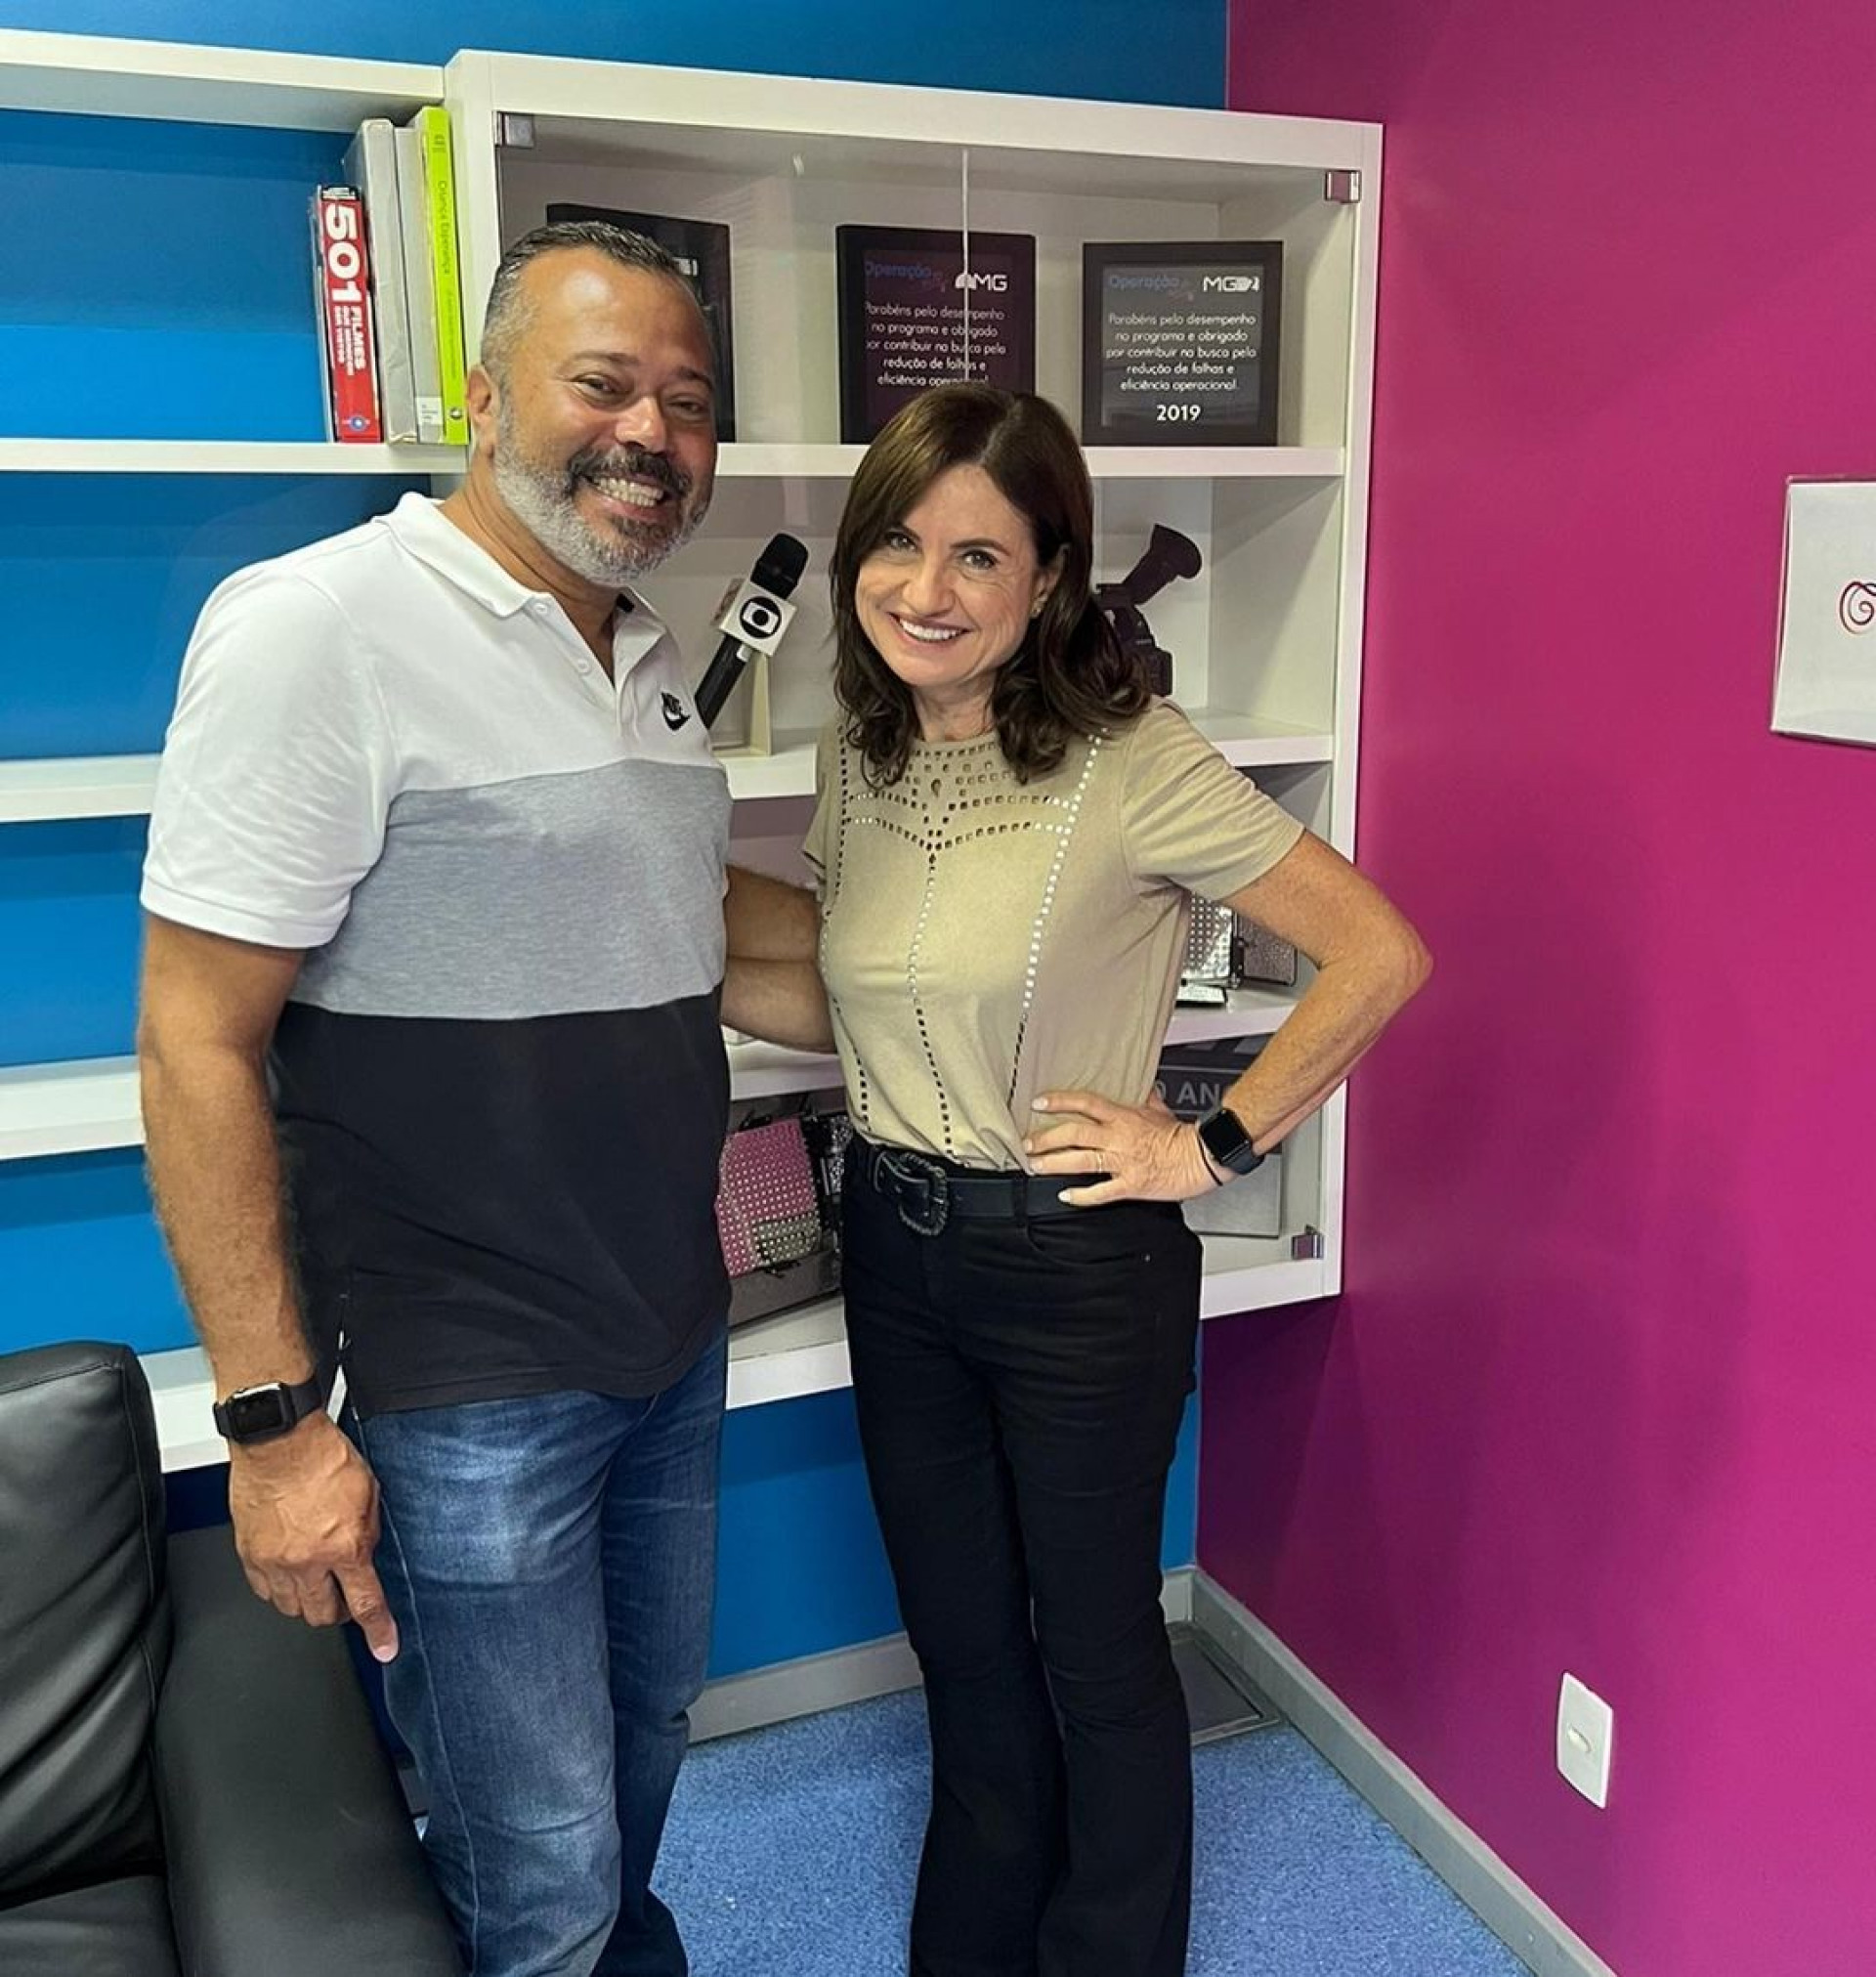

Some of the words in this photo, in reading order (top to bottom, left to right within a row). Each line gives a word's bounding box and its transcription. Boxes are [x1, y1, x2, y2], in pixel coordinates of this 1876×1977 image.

[325, 202, 362, 302] 501
[914, 304, 938, 319] pelo
[1109, 312, 1158, 324] Parabéns
[1160, 313, 1184, 326] pelo
[1186, 313, 1257, 326] desempenho
[351, 305, 367, 369] FILMES
[872, 323, 885, 333] no
[887, 323, 939, 336] programa
[941, 325, 949, 335] e
[1115, 332, 1130, 342] no
[1132, 332, 1185, 344] programa
[1187, 333, 1195, 342] e
[1198, 329, 1248, 344] obrigado
[883, 339, 932, 352] contribuir
[934, 342, 948, 353] na
[951, 340, 981, 354] buca
[1106, 349, 1125, 359] por
[1128, 346, 1178, 359] contribuir
[1180, 349, 1194, 359] na
[1197, 346, 1229, 359] busca
[883, 356, 927, 369] redução
[929, 357, 944, 369] de
[979, 362, 986, 370] e
[1127, 362, 1172, 375] redução
[1173, 362, 1188, 374] de
[1191, 362, 1223, 374] falhas
[1226, 365, 1235, 374] e
[877, 371, 926, 386] eficiência
[1120, 377, 1171, 391] eficiência
[1156, 404, 1201, 421] 2019
[1175, 1082, 1220, 1105] AN
